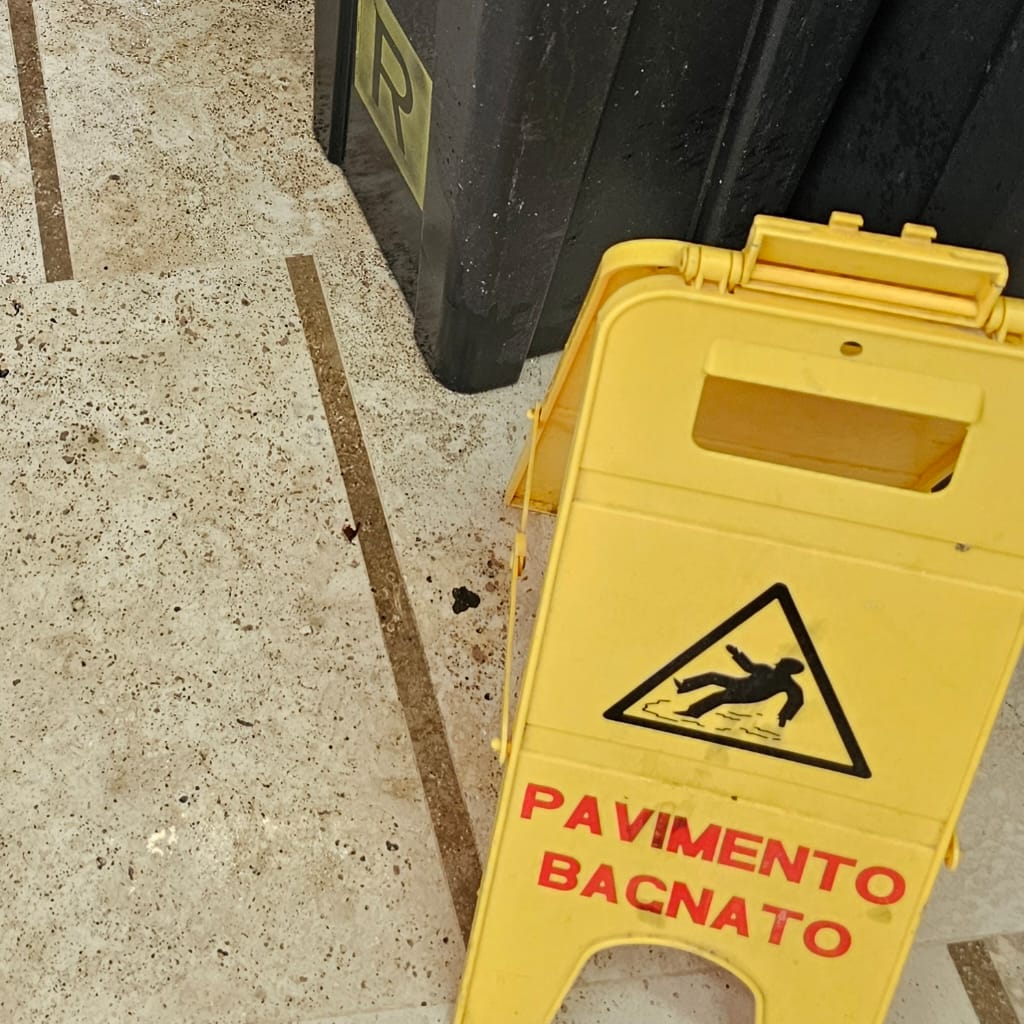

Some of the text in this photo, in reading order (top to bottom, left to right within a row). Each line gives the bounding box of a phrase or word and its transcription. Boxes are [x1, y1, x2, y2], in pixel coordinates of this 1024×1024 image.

[373, 13, 413, 154] R
[520, 783, 906, 905] PAVIMENTO
[537, 851, 852, 958] BAGNATO
